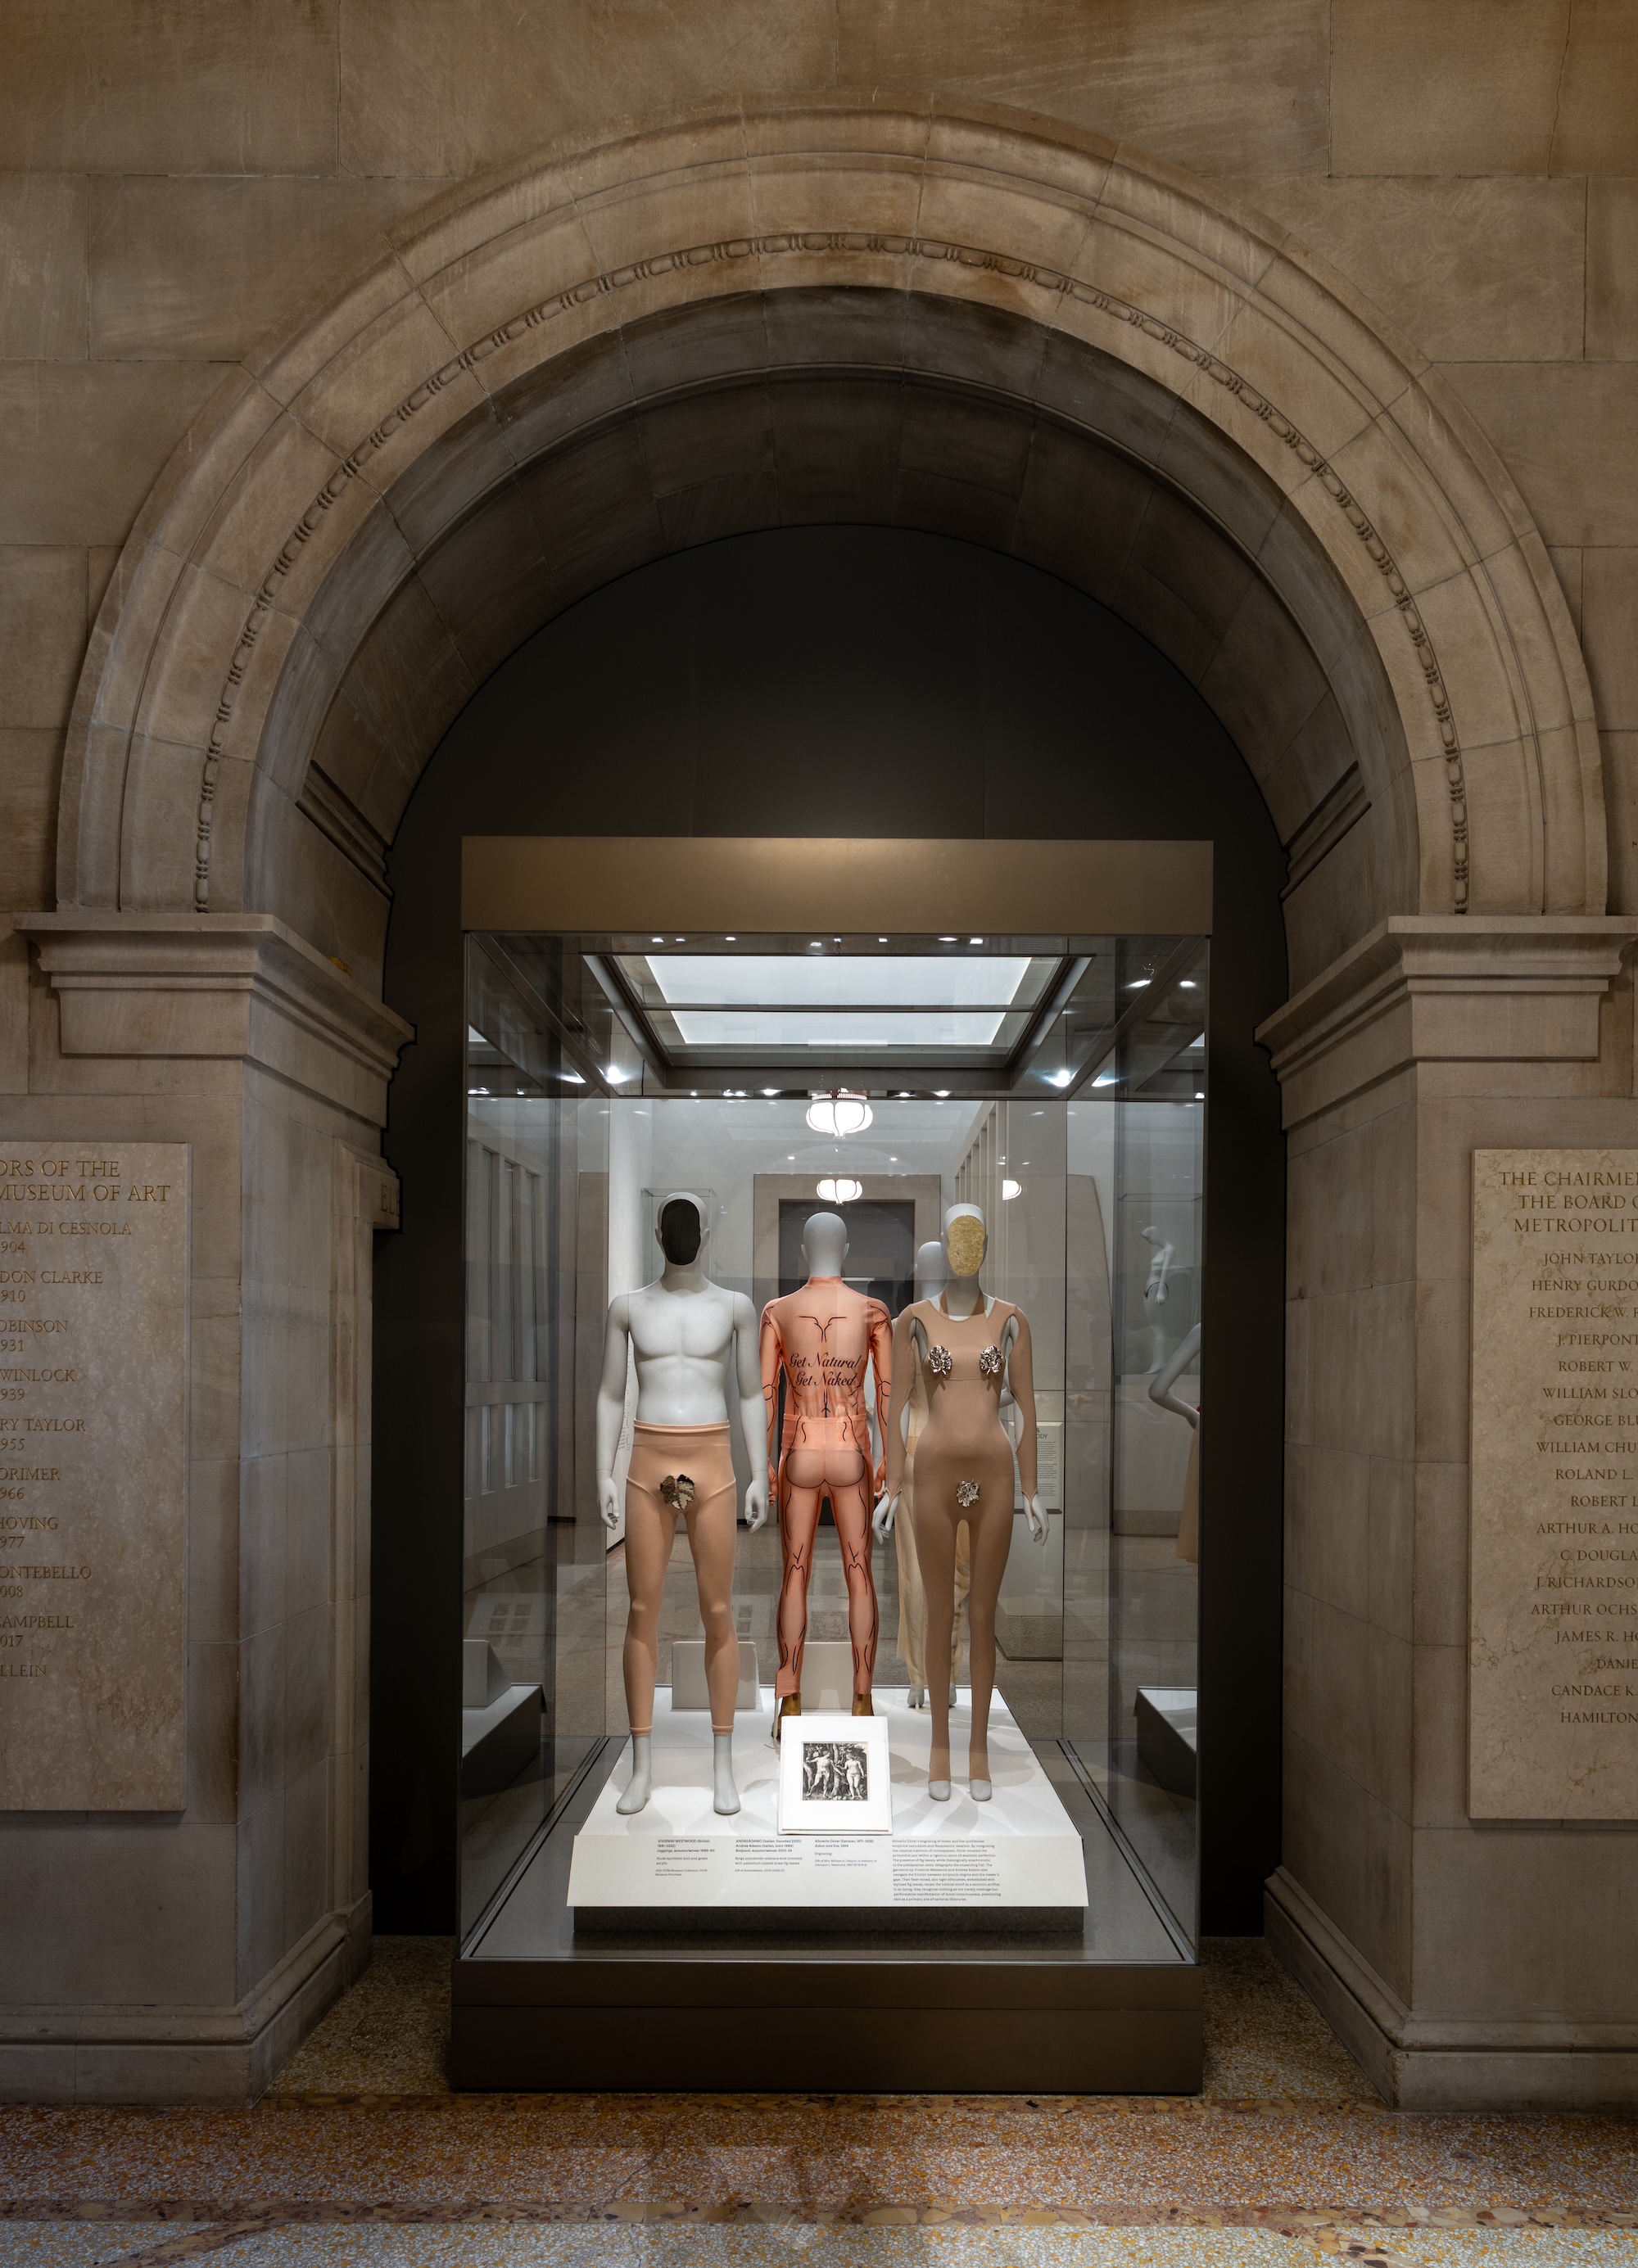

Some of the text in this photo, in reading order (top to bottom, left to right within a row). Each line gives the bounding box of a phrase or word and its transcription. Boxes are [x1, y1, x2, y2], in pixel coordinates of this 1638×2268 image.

[41, 1160, 70, 1177] OF
[76, 1160, 120, 1177] THE
[1499, 1172, 1638, 1186] THE CHAIRME
[93, 1185, 121, 1201] OF
[127, 1185, 170, 1201] ART
[1518, 1195, 1556, 1209] THE
[1563, 1195, 1626, 1209] BOARD
[37, 1222, 54, 1235] DI
[58, 1222, 132, 1236] CESNOLA
[1514, 1218, 1638, 1232] METROPOLIT
[0, 1241, 25, 1254] 904
[1543, 1253, 1583, 1267] JOHN
[41, 1271, 103, 1284] CLARKE
[1532, 1280, 1638, 1291] HENRY GURDO
[0, 1290, 25, 1303] 910
[1529, 1307, 1611, 1318] FREDERICK
[1614, 1307, 1629, 1318] W.
[0, 1339, 25, 1352] 931
[1556, 1335, 1565, 1348] J.
[790, 1352, 862, 1369] Get Natural
[1559, 1361, 1633, 1372] ROBERT W.
[0, 1369, 75, 1382] WINLOCK
[795, 1371, 857, 1386] Get Naked
[1542, 1388, 1607, 1399] WILLIAM
[24, 1418, 86, 1431] TAYLOR
[1554, 1415, 1612, 1426] GEORGE
[0, 1438, 25, 1451] 955
[1536, 1442, 1637, 1453] WILLIAM CHU
[1555, 1469, 1633, 1480] ROLAND L.
[1571, 1496, 1627, 1507] ROBERT
[1536, 1523, 1598, 1534] ARTHUR
[1600, 1523, 1614, 1534] A.
[1560, 1550, 1572, 1561] C.
[1535, 1577, 1638, 1590] J. RICHARDSO
[1532, 1604, 1638, 1615] ARTHUR OCHS
[0, 1615, 74, 1629] AMPBELL
[1554, 1630, 1601, 1645] JAMES
[1606, 1631, 1618, 1642] R.
[1597, 1659, 1638, 1669] DANIE
[1551, 1685, 1638, 1696] CANDACE K.
[1560, 1712, 1638, 1724] HAMILTON
